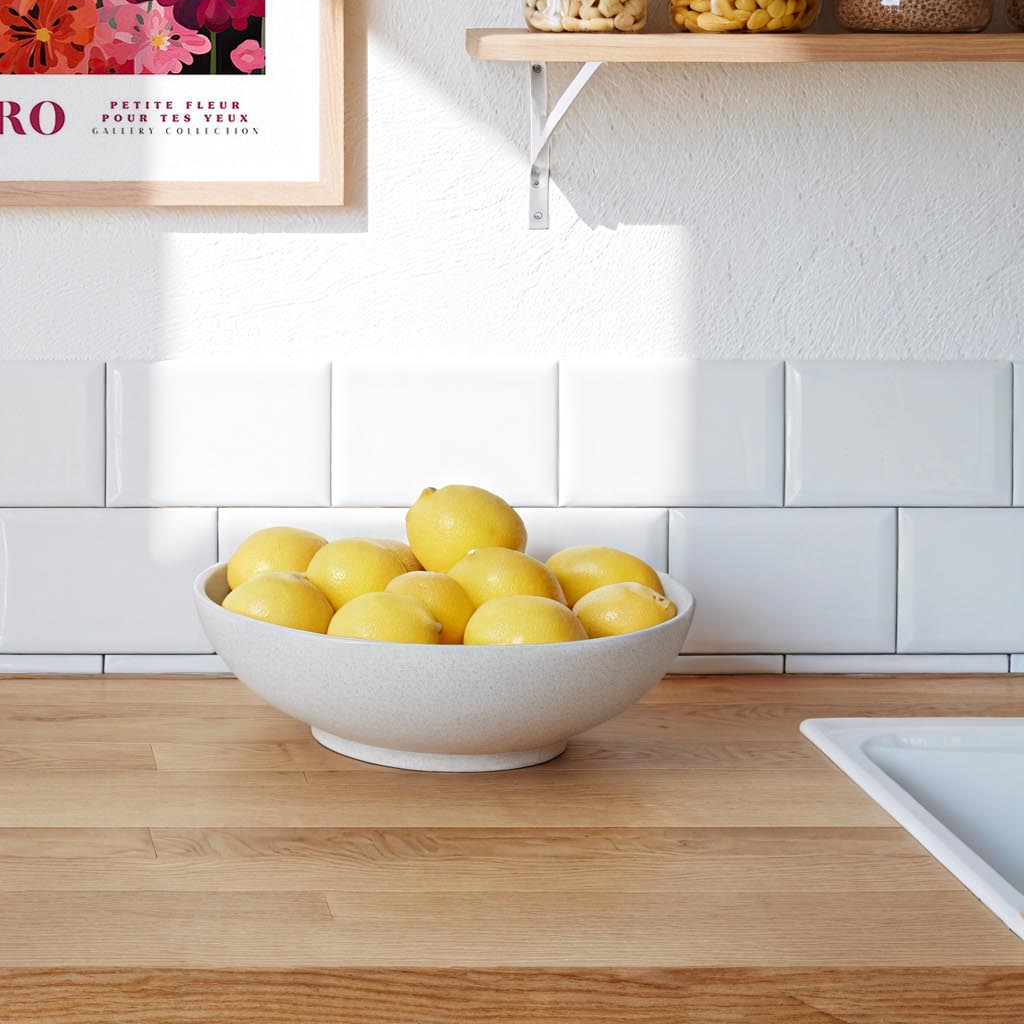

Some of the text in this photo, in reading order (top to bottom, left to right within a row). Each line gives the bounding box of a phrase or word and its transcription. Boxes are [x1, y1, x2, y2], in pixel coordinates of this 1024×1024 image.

[110, 100, 241, 110] PETITE FLEUR
[102, 113, 249, 123] POUR TES YEUX
[91, 127, 260, 136] GALLERY COLLECTION
